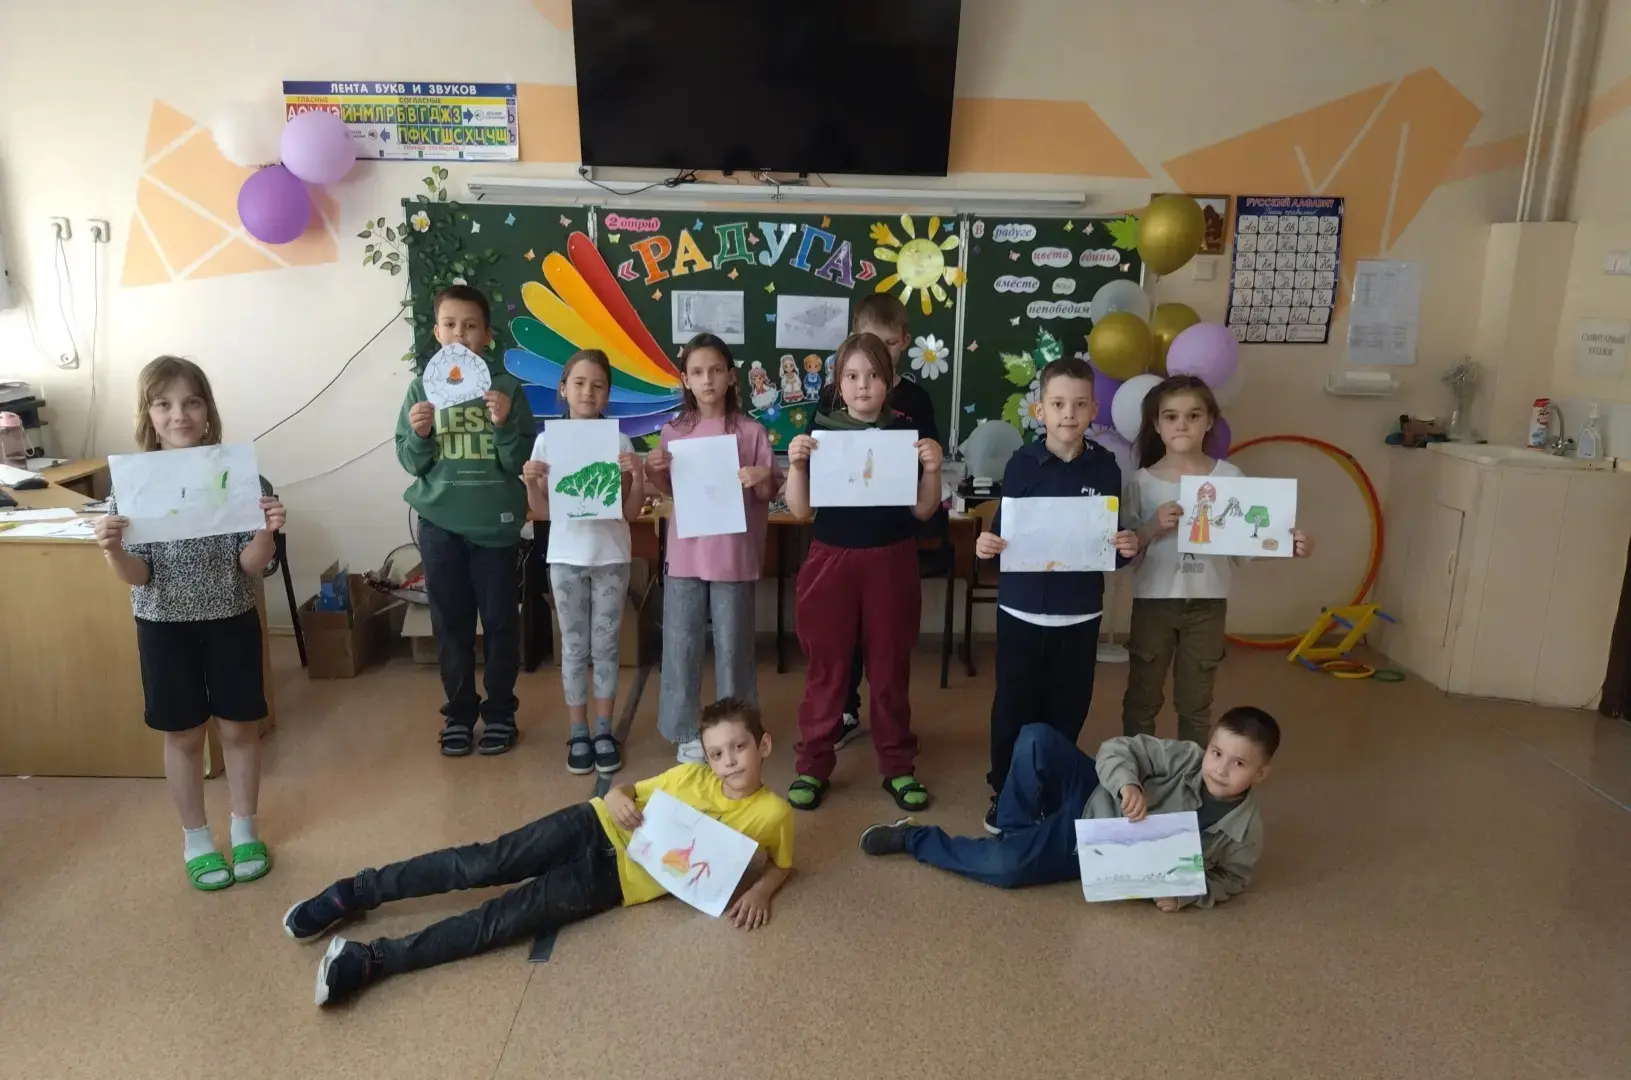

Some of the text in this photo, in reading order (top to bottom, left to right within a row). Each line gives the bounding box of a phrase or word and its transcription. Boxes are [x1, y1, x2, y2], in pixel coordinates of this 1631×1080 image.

[330, 83, 477, 95] ЛЕНТА БУКВ И ЗВУКОВ
[1245, 197, 1291, 208] РУССКИЙ
[608, 217, 659, 230] 2 отряд
[995, 226, 1032, 239] радуге
[1033, 251, 1070, 261] цвета
[995, 279, 1038, 289] вместе
[1028, 302, 1091, 315] непобедим
